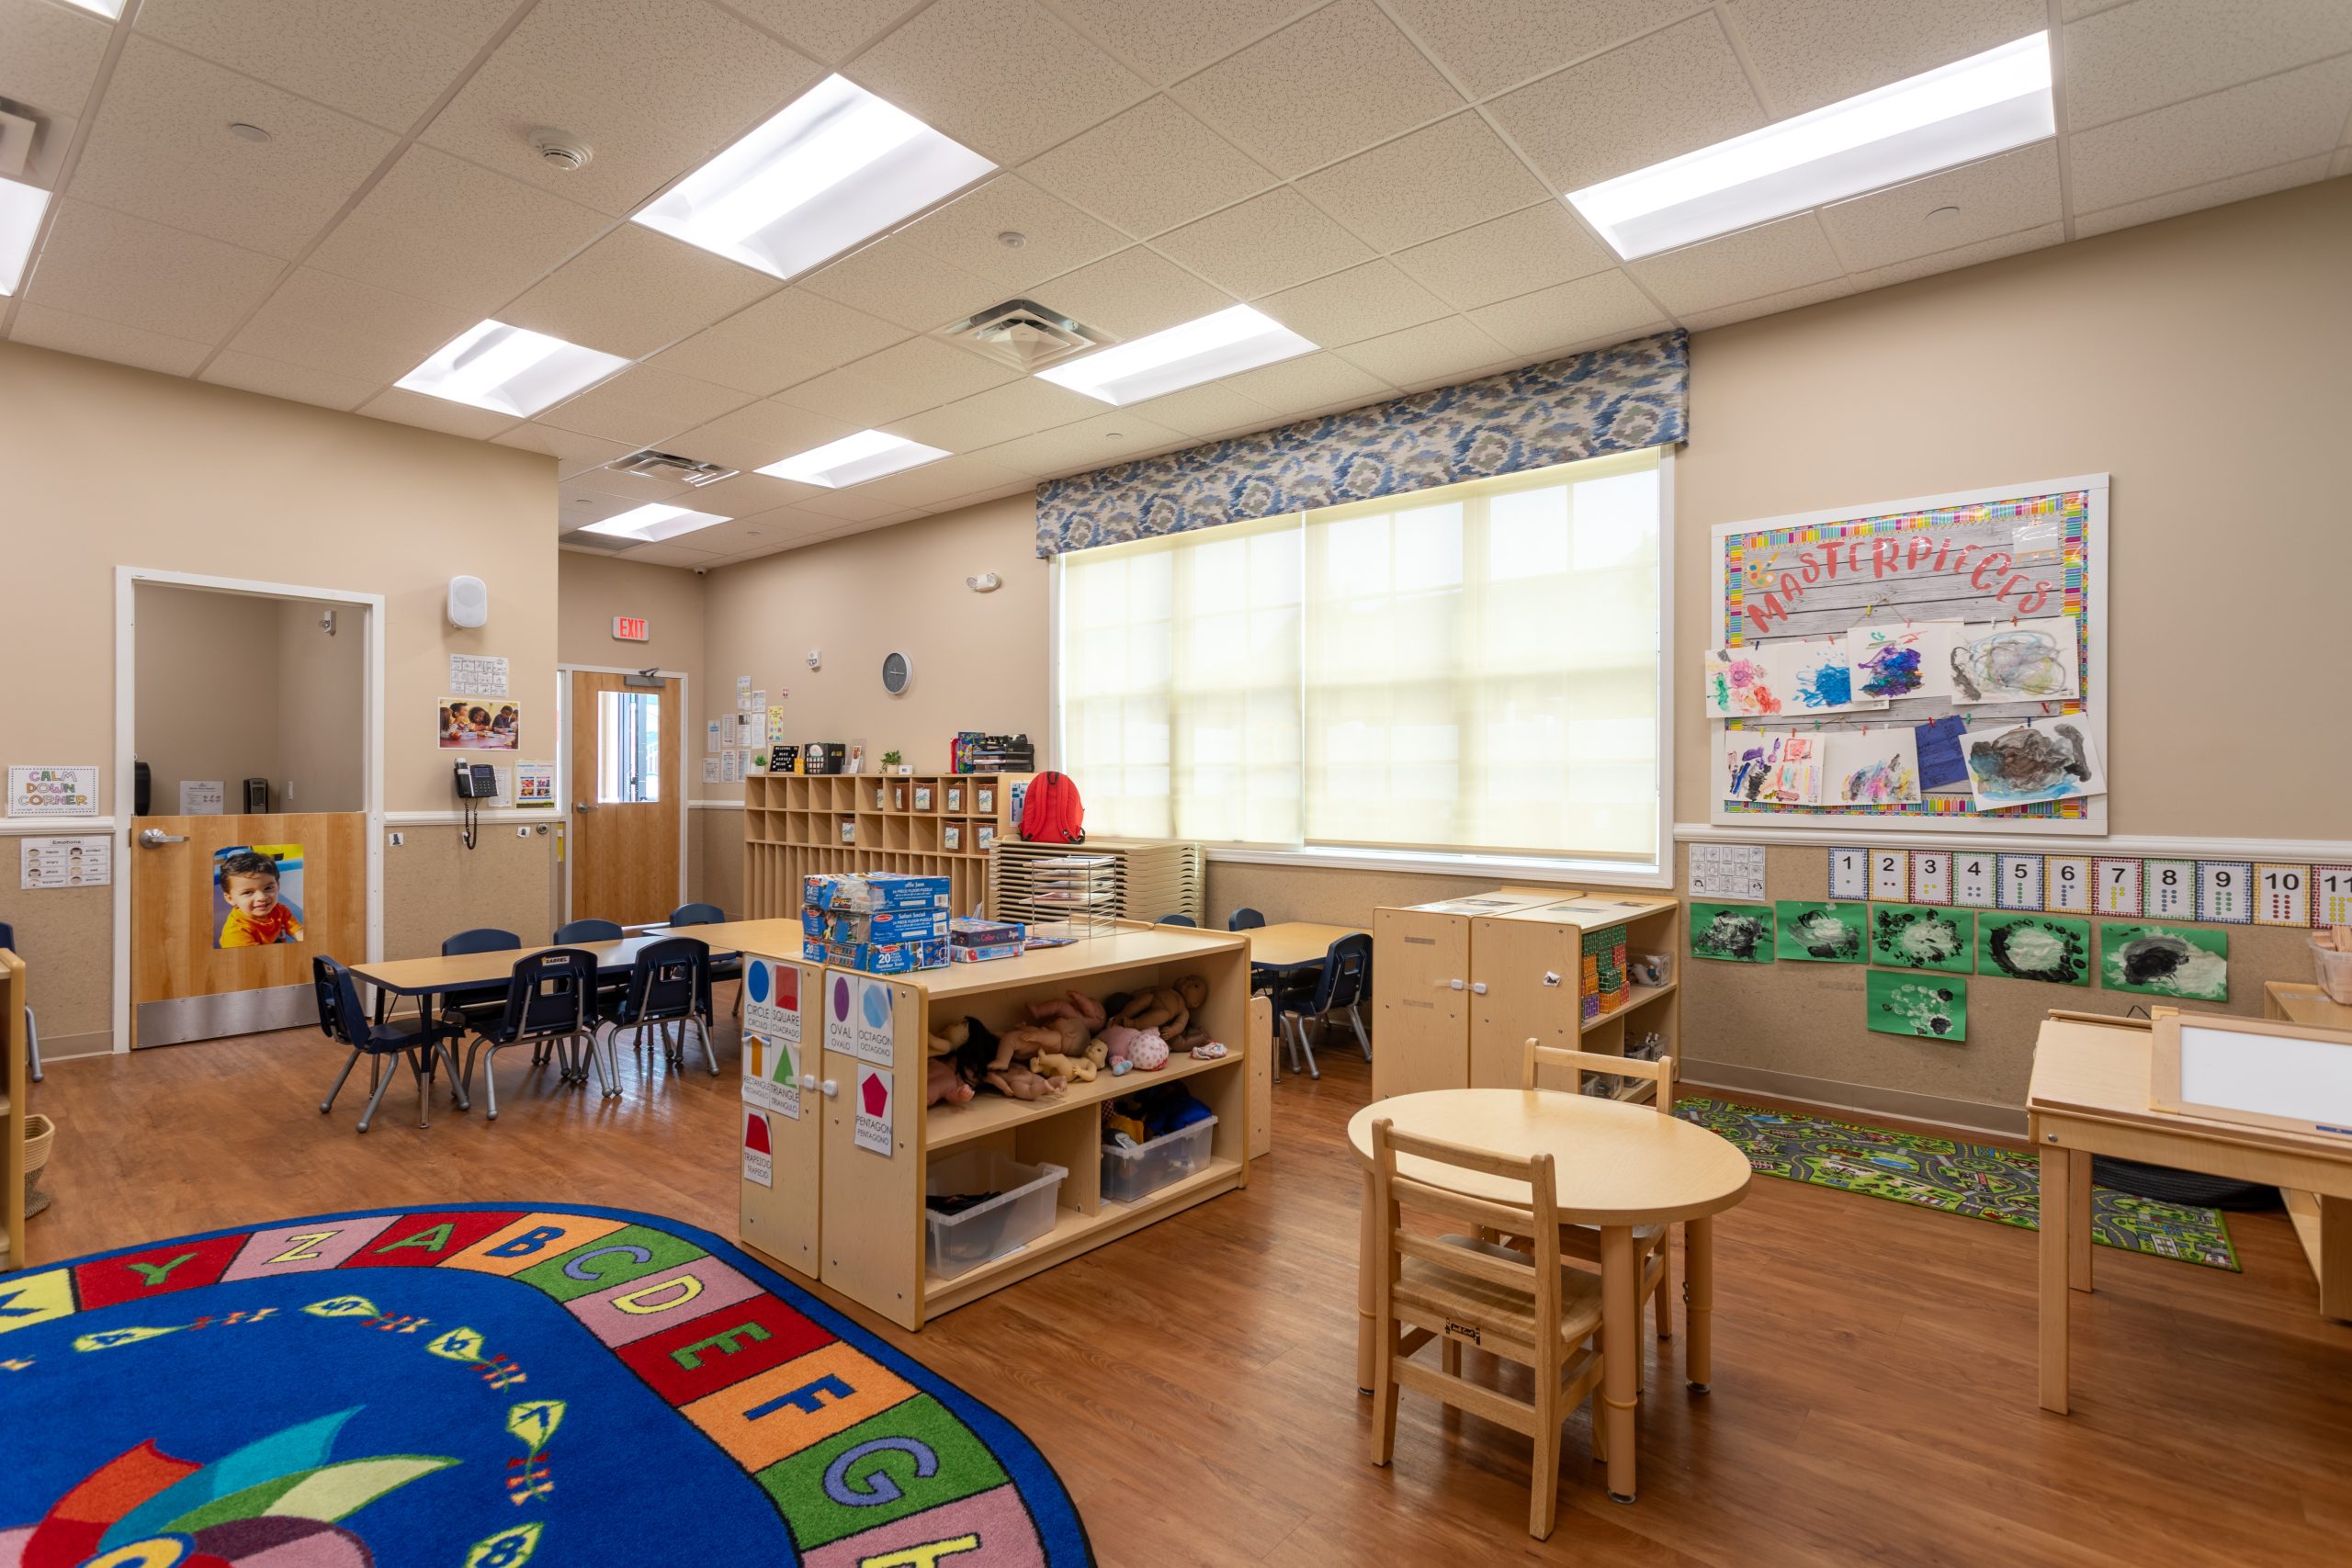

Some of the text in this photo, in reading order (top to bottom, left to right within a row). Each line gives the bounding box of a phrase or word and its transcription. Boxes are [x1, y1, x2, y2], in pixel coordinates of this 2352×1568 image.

[1747, 536, 2053, 634] MASTERPIECES
[618, 617, 646, 640] EXIT
[29, 771, 77, 782] CALM
[26, 783, 75, 794] DOWN
[18, 795, 87, 806] CORNER
[1843, 856, 2352, 893] 1 2 3 4 5 6 7 8 9 10 11
[980, 933, 995, 942] Color
[806, 944, 814, 953] 20
[878, 953, 891, 964] 20
[747, 1003, 770, 1020] CIRCLE
[772, 1010, 799, 1027] SQUARE
[772, 1023, 799, 1038] CUADRADO
[831, 1022, 853, 1039] OVAL
[858, 1030, 892, 1045] OCTAGON
[743, 1075, 771, 1090] RECTANGLE
[770, 1084, 799, 1102] TRIANGLE
[856, 1115, 892, 1134] PENTAGON
[743, 1152, 771, 1169] TRAPEZOID
[125, 1223, 940, 1507] Y Z A B C D E F G
[93, 1299, 550, 1568] 4 5 6 7 8
